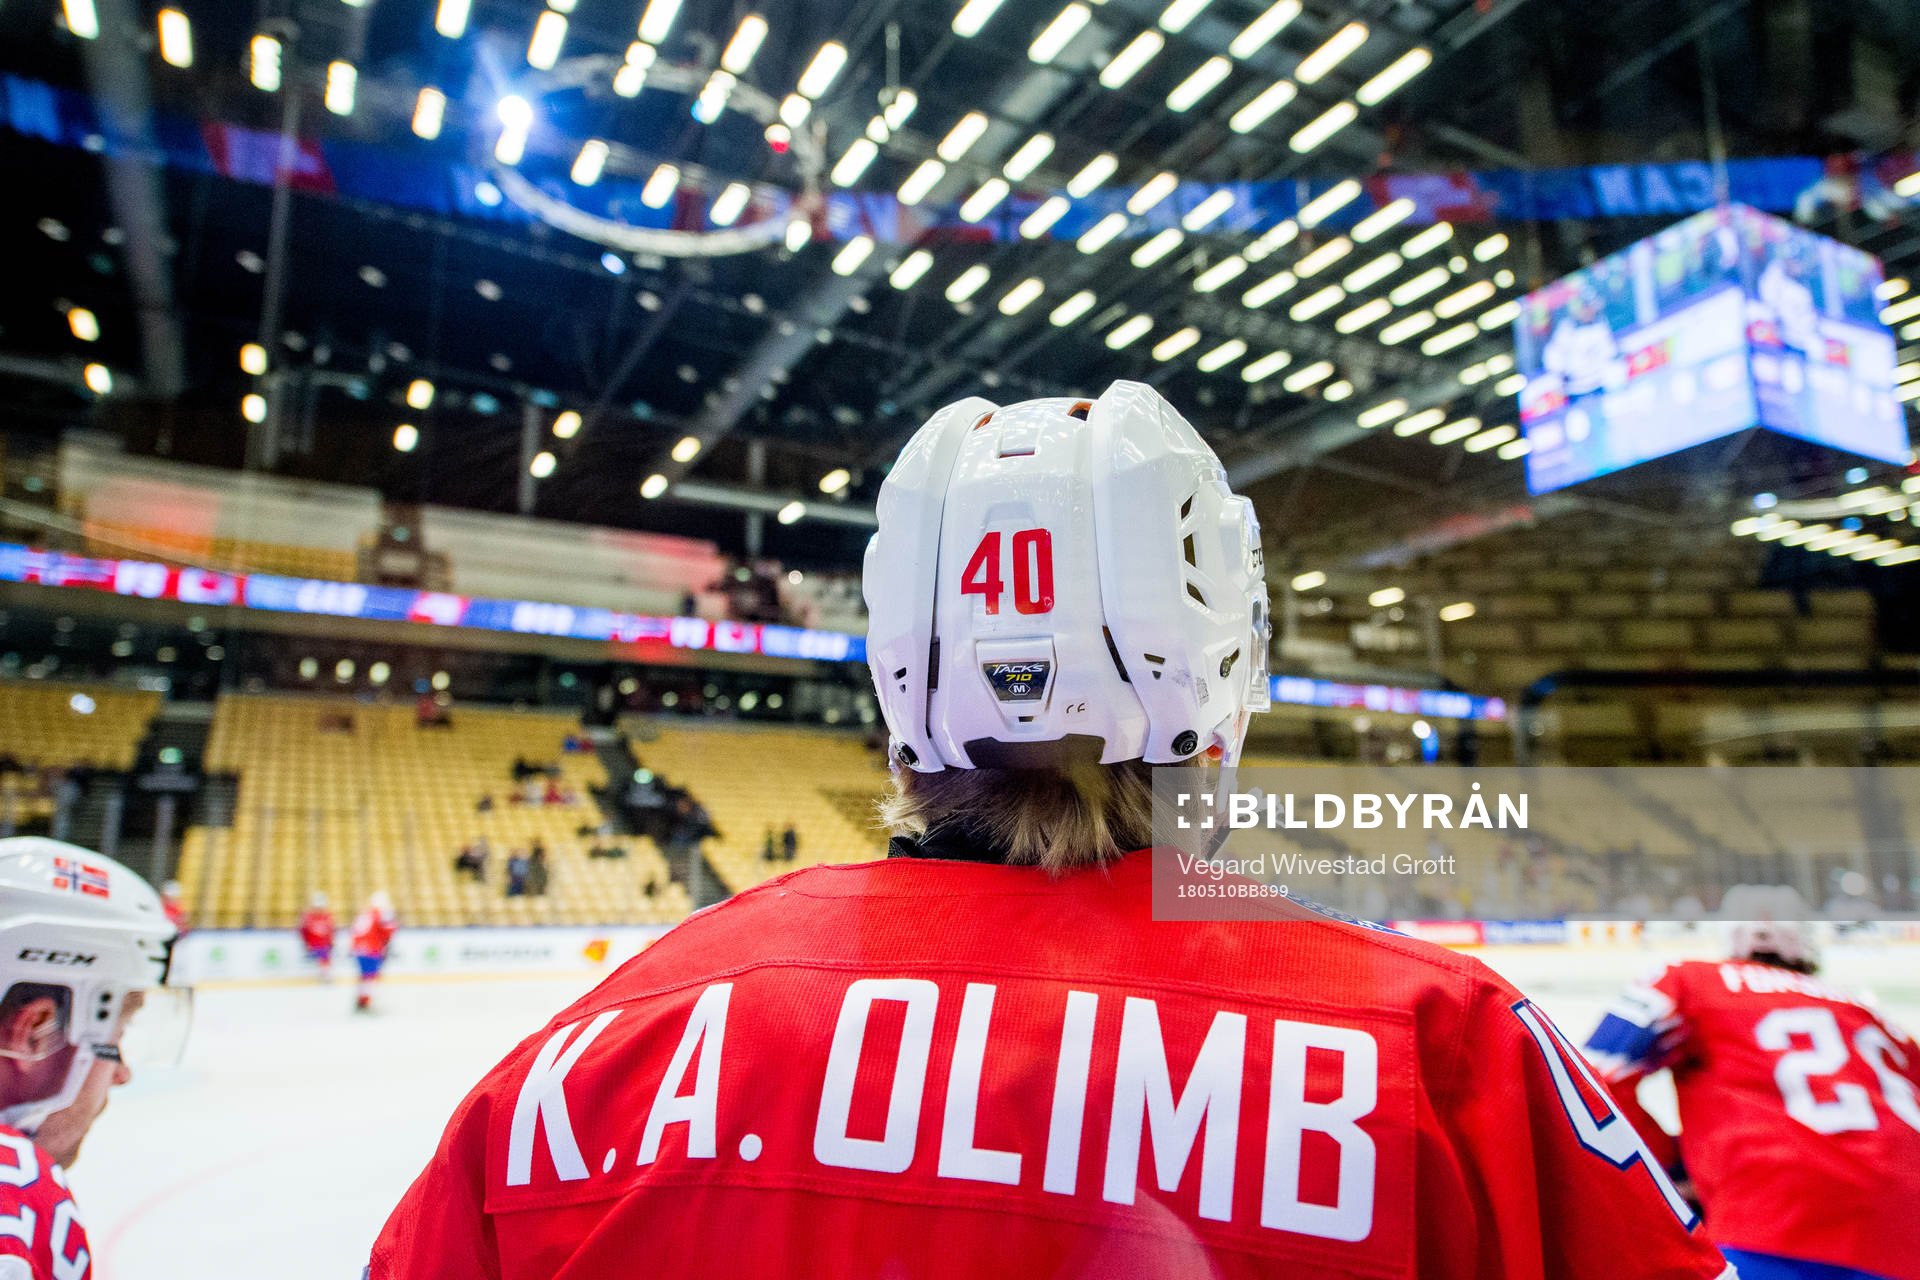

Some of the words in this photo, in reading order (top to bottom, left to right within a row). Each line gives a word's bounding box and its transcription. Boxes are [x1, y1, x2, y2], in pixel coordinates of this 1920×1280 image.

[961, 528, 1054, 615] 40
[992, 663, 1044, 676] TACKS
[1005, 674, 1032, 682] 710
[1013, 685, 1026, 693] M
[18, 949, 97, 966] CCM
[812, 978, 1378, 1243] OLIMB
